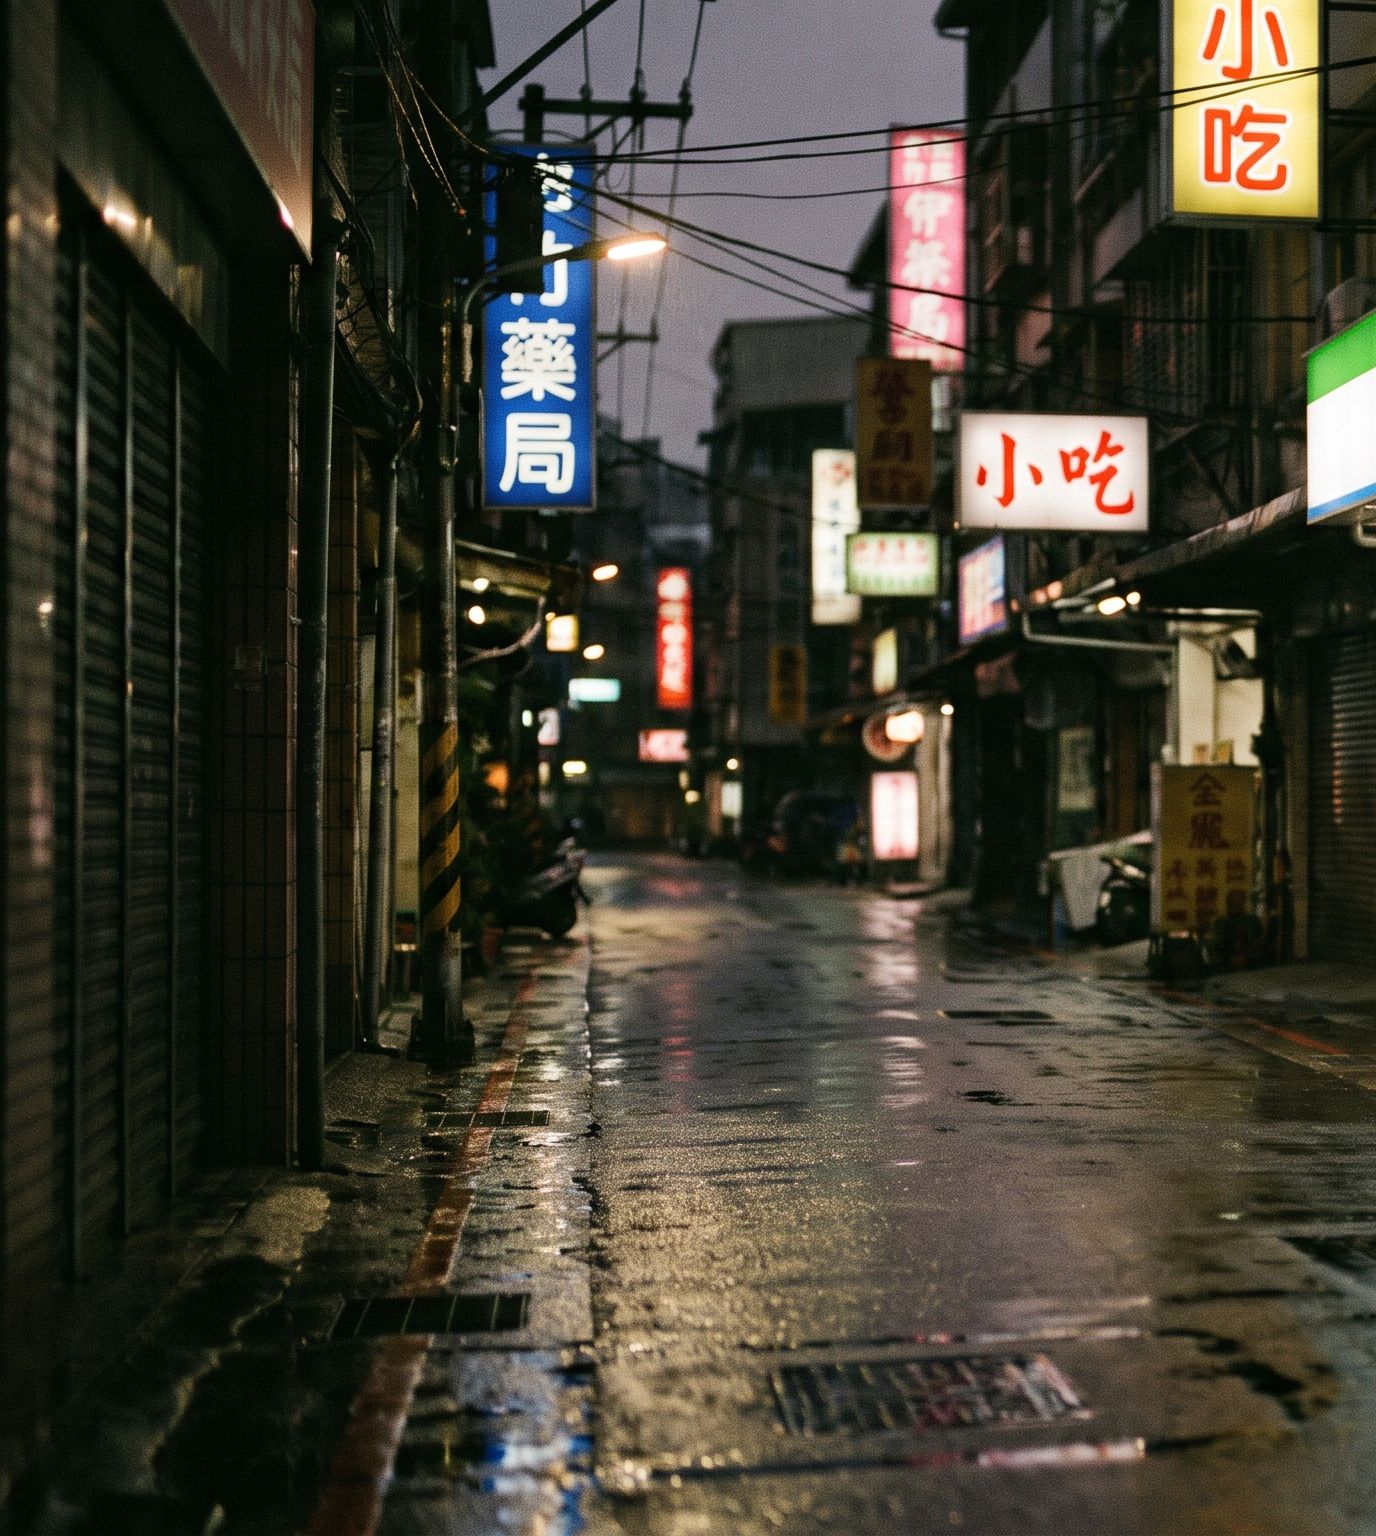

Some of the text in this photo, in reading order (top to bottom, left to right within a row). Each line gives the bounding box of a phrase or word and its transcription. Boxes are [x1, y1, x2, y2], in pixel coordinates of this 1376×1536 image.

[1203, 0, 1288, 190] 小吃
[499, 152, 577, 495] 藥局
[976, 430, 1135, 515] 小吃
